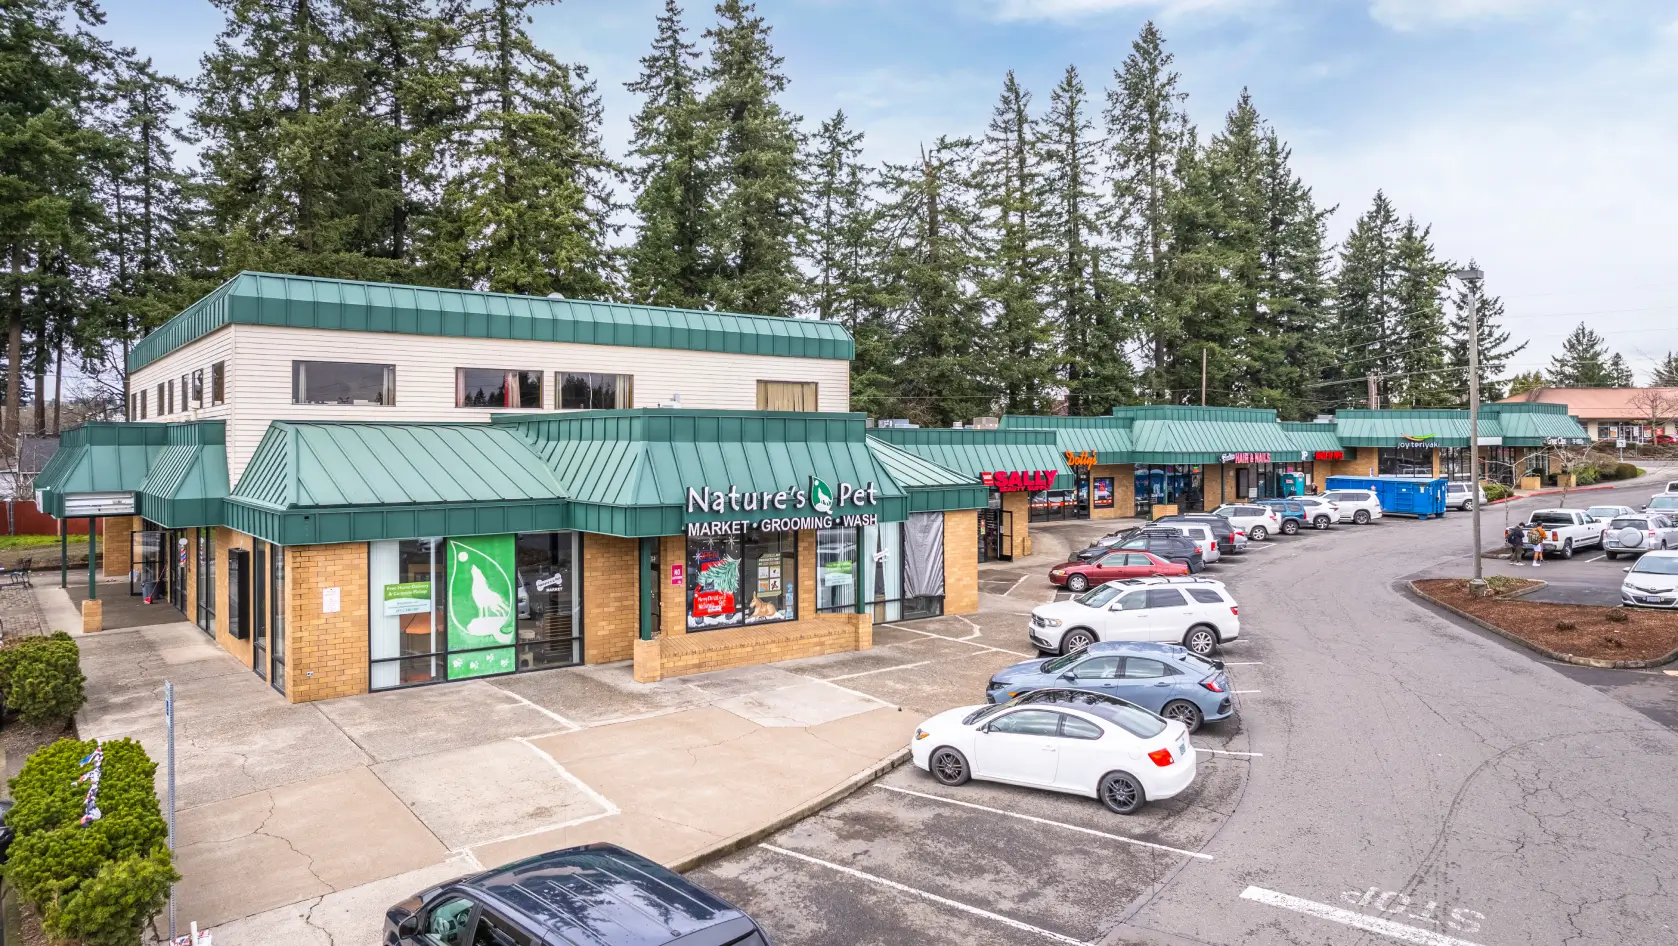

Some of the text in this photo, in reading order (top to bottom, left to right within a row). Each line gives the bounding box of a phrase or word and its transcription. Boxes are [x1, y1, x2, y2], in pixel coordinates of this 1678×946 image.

[1411, 441, 1440, 449] teriyaki
[1065, 450, 1097, 470] Dotty's
[1235, 453, 1249, 463] HAIR
[1255, 453, 1271, 463] NAILS
[993, 470, 1057, 487] SALLY
[687, 481, 878, 513] Nature's Pet
[688, 514, 878, 536] MARKET GROOMING WASH
[699, 551, 719, 560] OPEN
[1340, 886, 1485, 933] STOP
